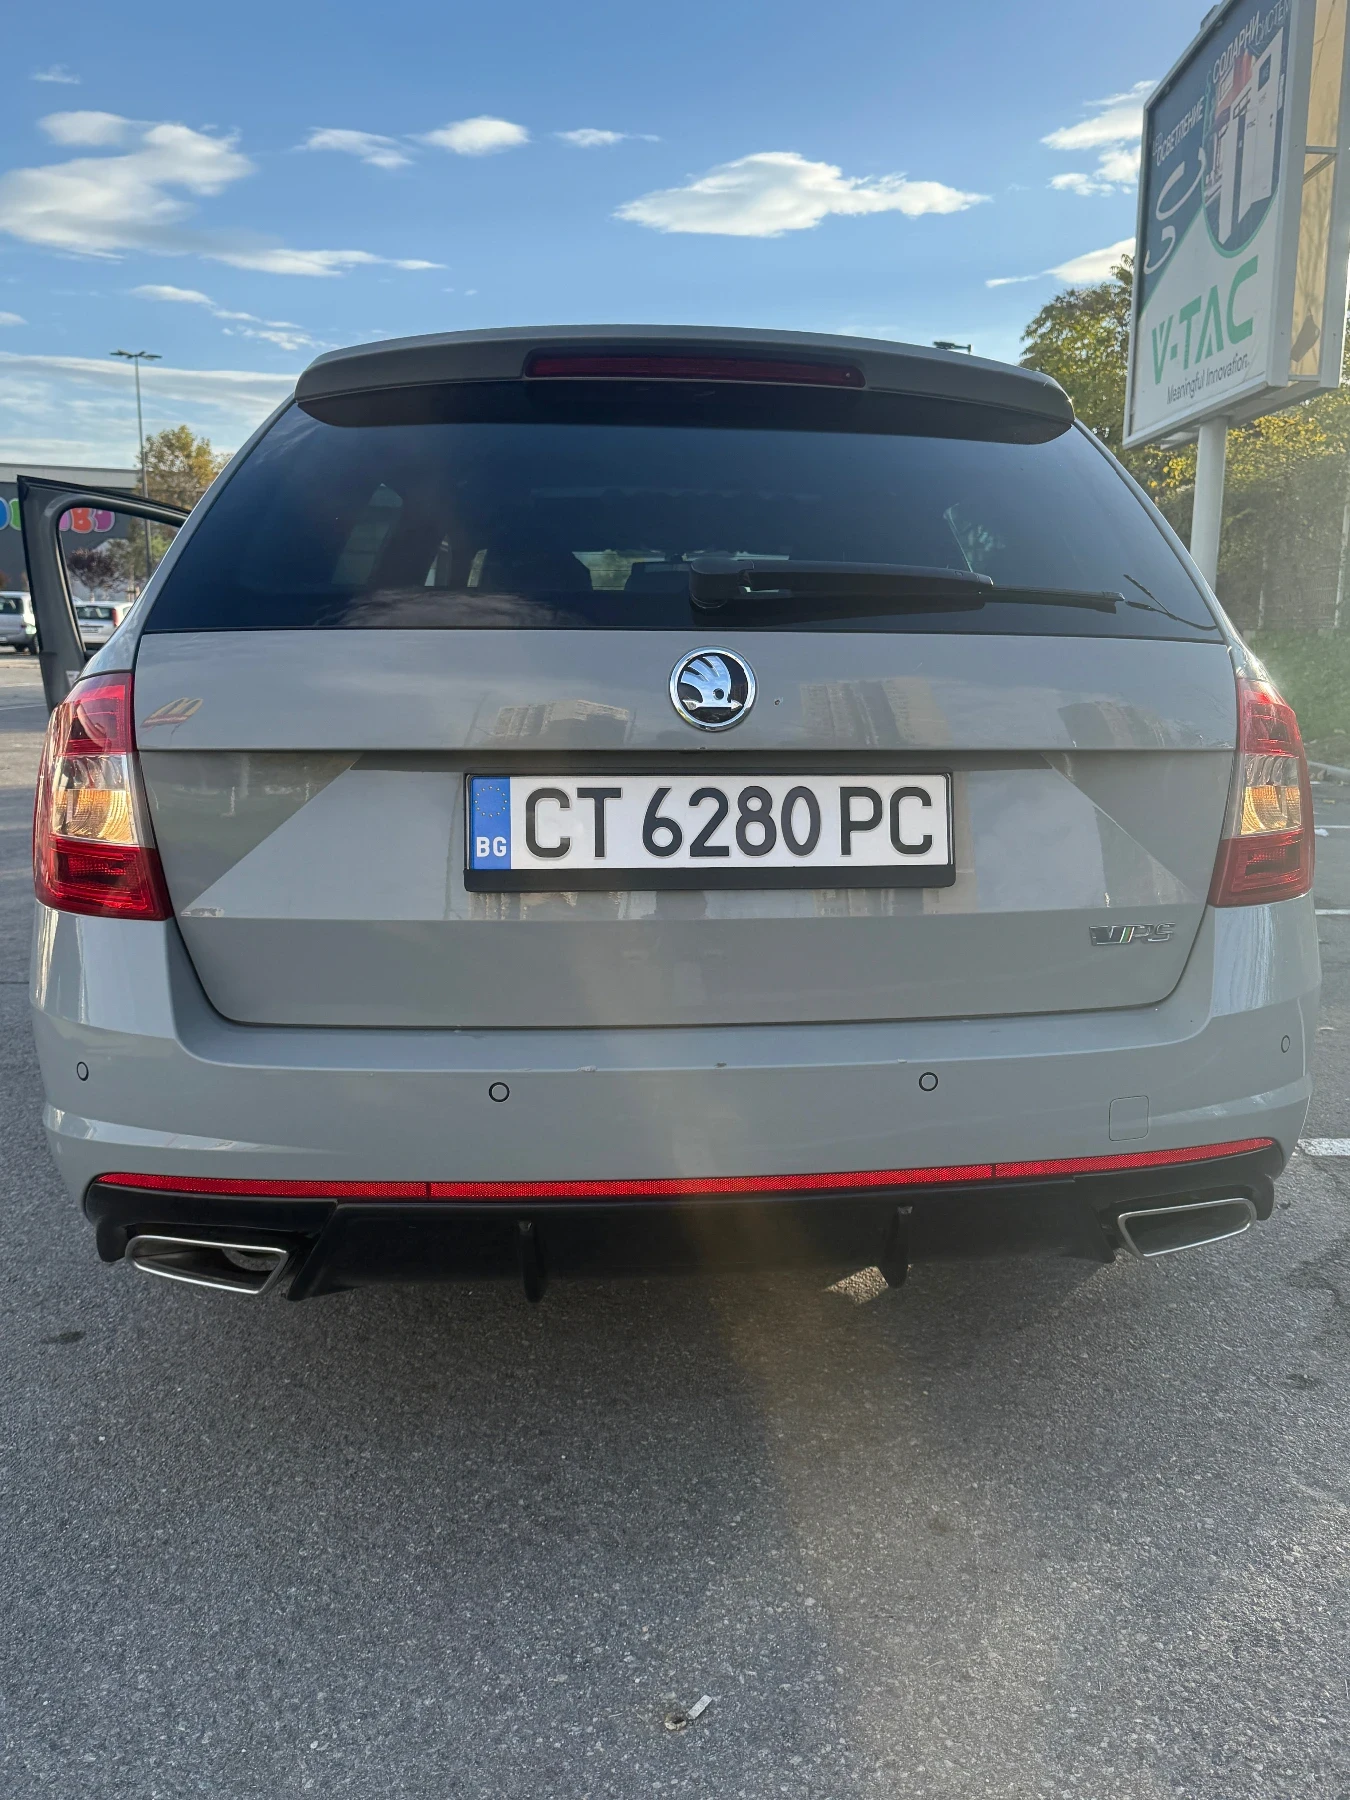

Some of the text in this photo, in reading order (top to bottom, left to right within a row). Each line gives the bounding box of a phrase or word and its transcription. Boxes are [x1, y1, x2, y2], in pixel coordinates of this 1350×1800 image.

[1152, 254, 1259, 386] V-TAC
[1166, 370, 1206, 405] Meaningful
[475, 837, 507, 857] BG
[525, 786, 934, 858] CT 6280 PC
